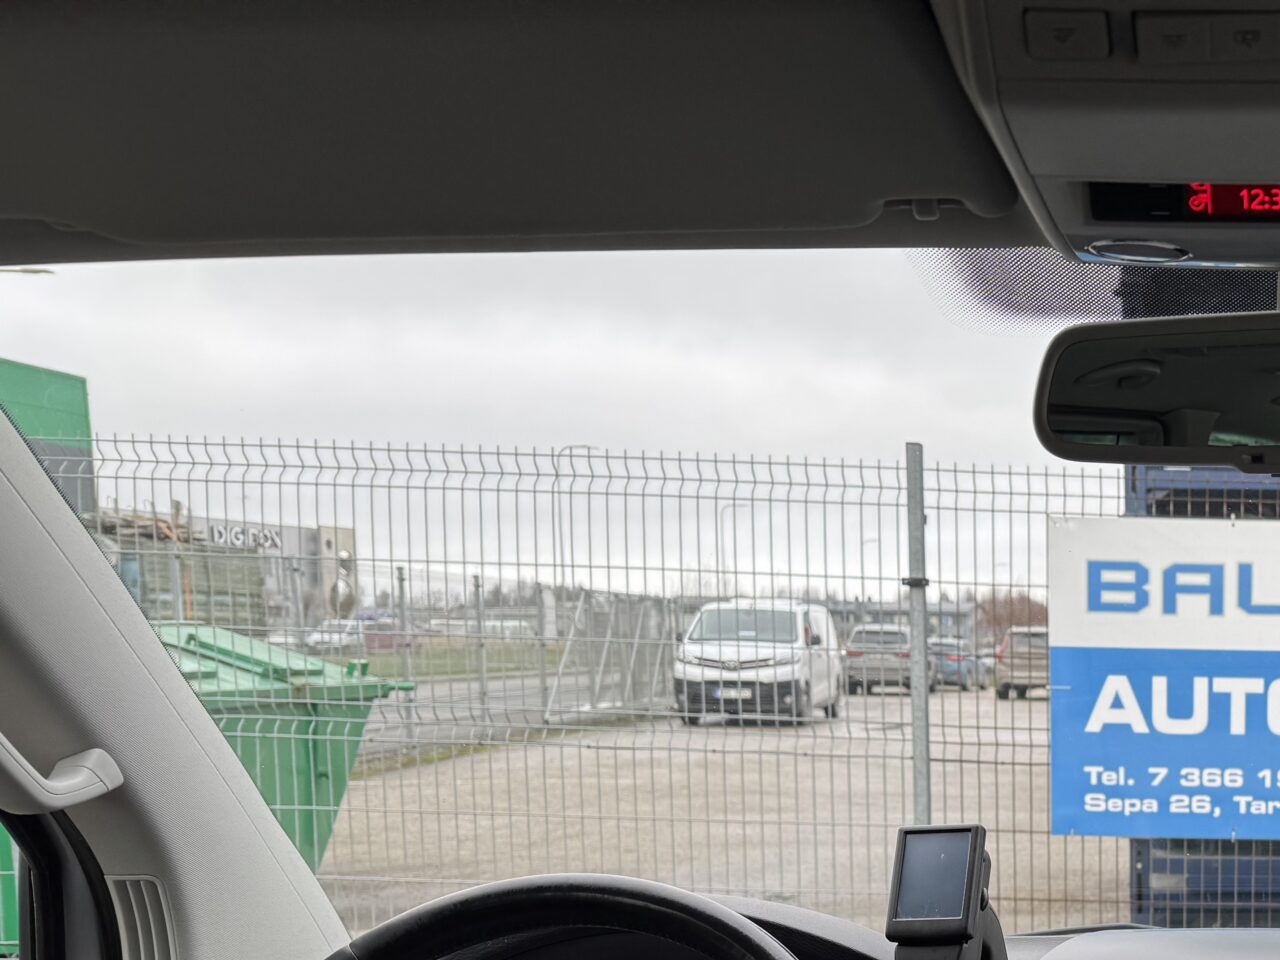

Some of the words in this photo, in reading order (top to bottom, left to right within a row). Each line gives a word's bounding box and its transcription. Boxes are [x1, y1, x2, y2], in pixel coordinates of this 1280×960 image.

[1083, 765, 1135, 786] Tel.
[1148, 767, 1168, 786] 7
[1180, 767, 1244, 788] 366
[1084, 793, 1158, 816] Sepa
[1169, 794, 1221, 818] 26,
